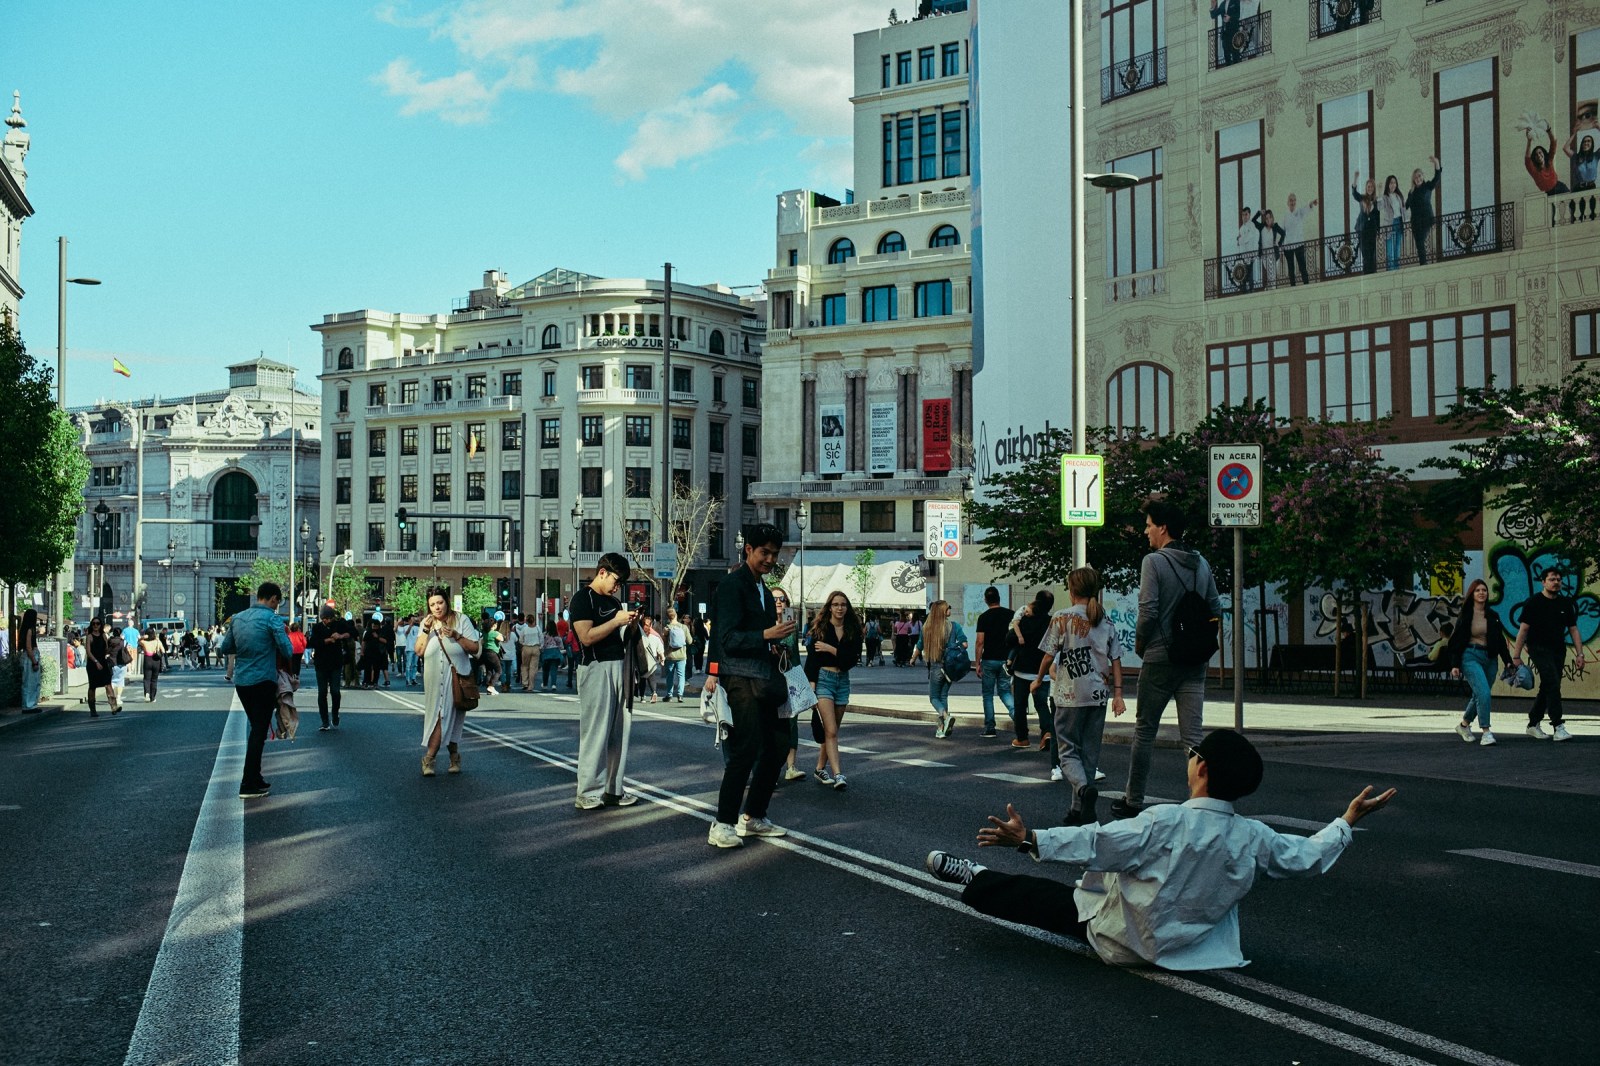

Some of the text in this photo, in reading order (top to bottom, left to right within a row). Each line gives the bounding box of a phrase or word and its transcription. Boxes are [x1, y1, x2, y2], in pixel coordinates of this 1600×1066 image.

[596, 338, 638, 347] EDIFICIO
[824, 440, 841, 451] CLÁ
[826, 451, 840, 459] SIC
[829, 460, 836, 468] A
